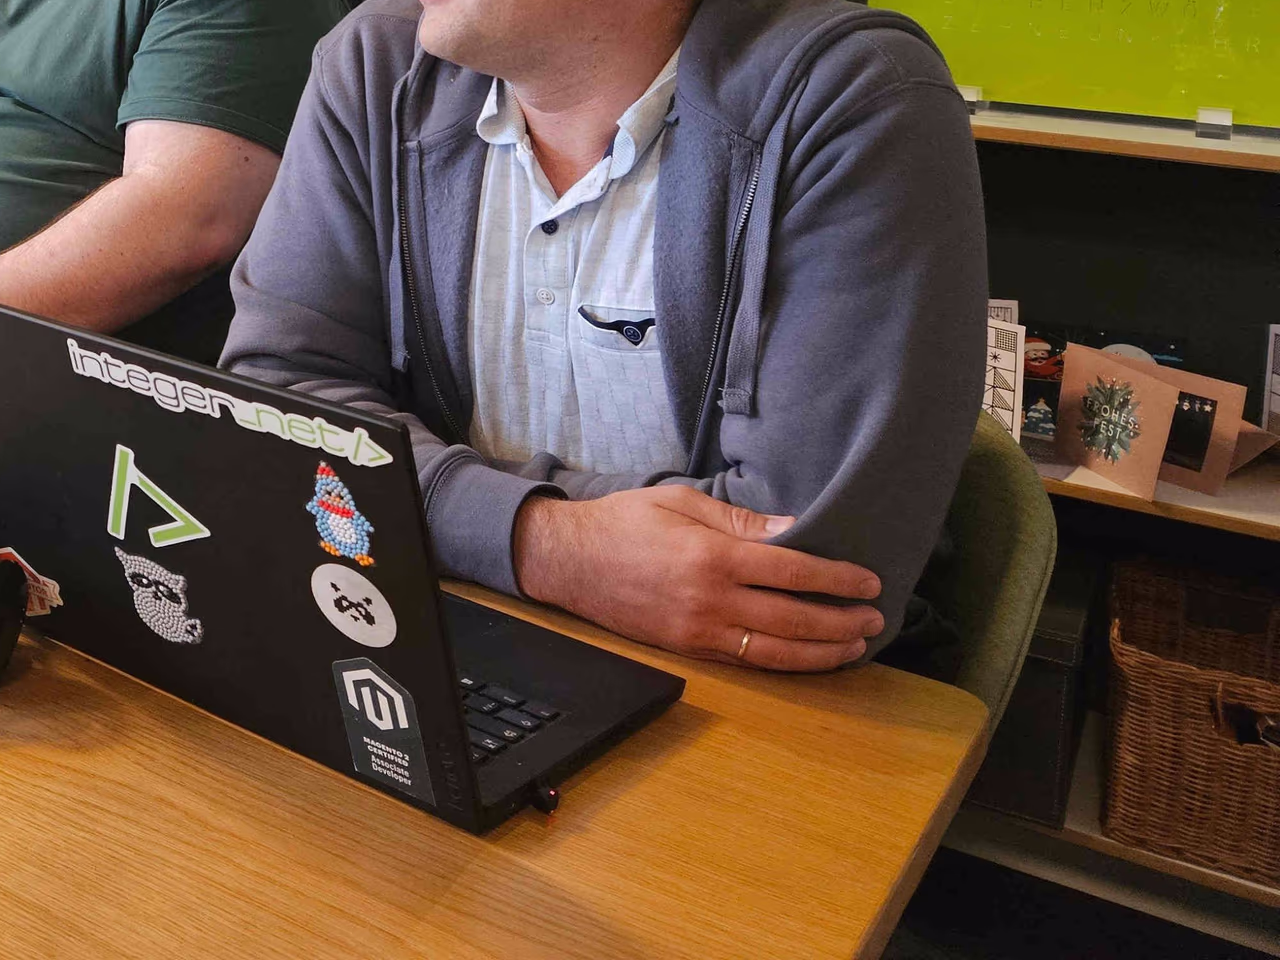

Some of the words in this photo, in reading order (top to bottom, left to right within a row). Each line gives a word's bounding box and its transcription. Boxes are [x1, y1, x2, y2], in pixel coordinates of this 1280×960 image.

[1086, 397, 1135, 430] FROHES
[1093, 418, 1123, 439] FEST
[363, 736, 403, 759] MAGENTO
[367, 745, 409, 767] CERTIFIED
[371, 755, 410, 778] Associate
[371, 762, 412, 786] Developer
